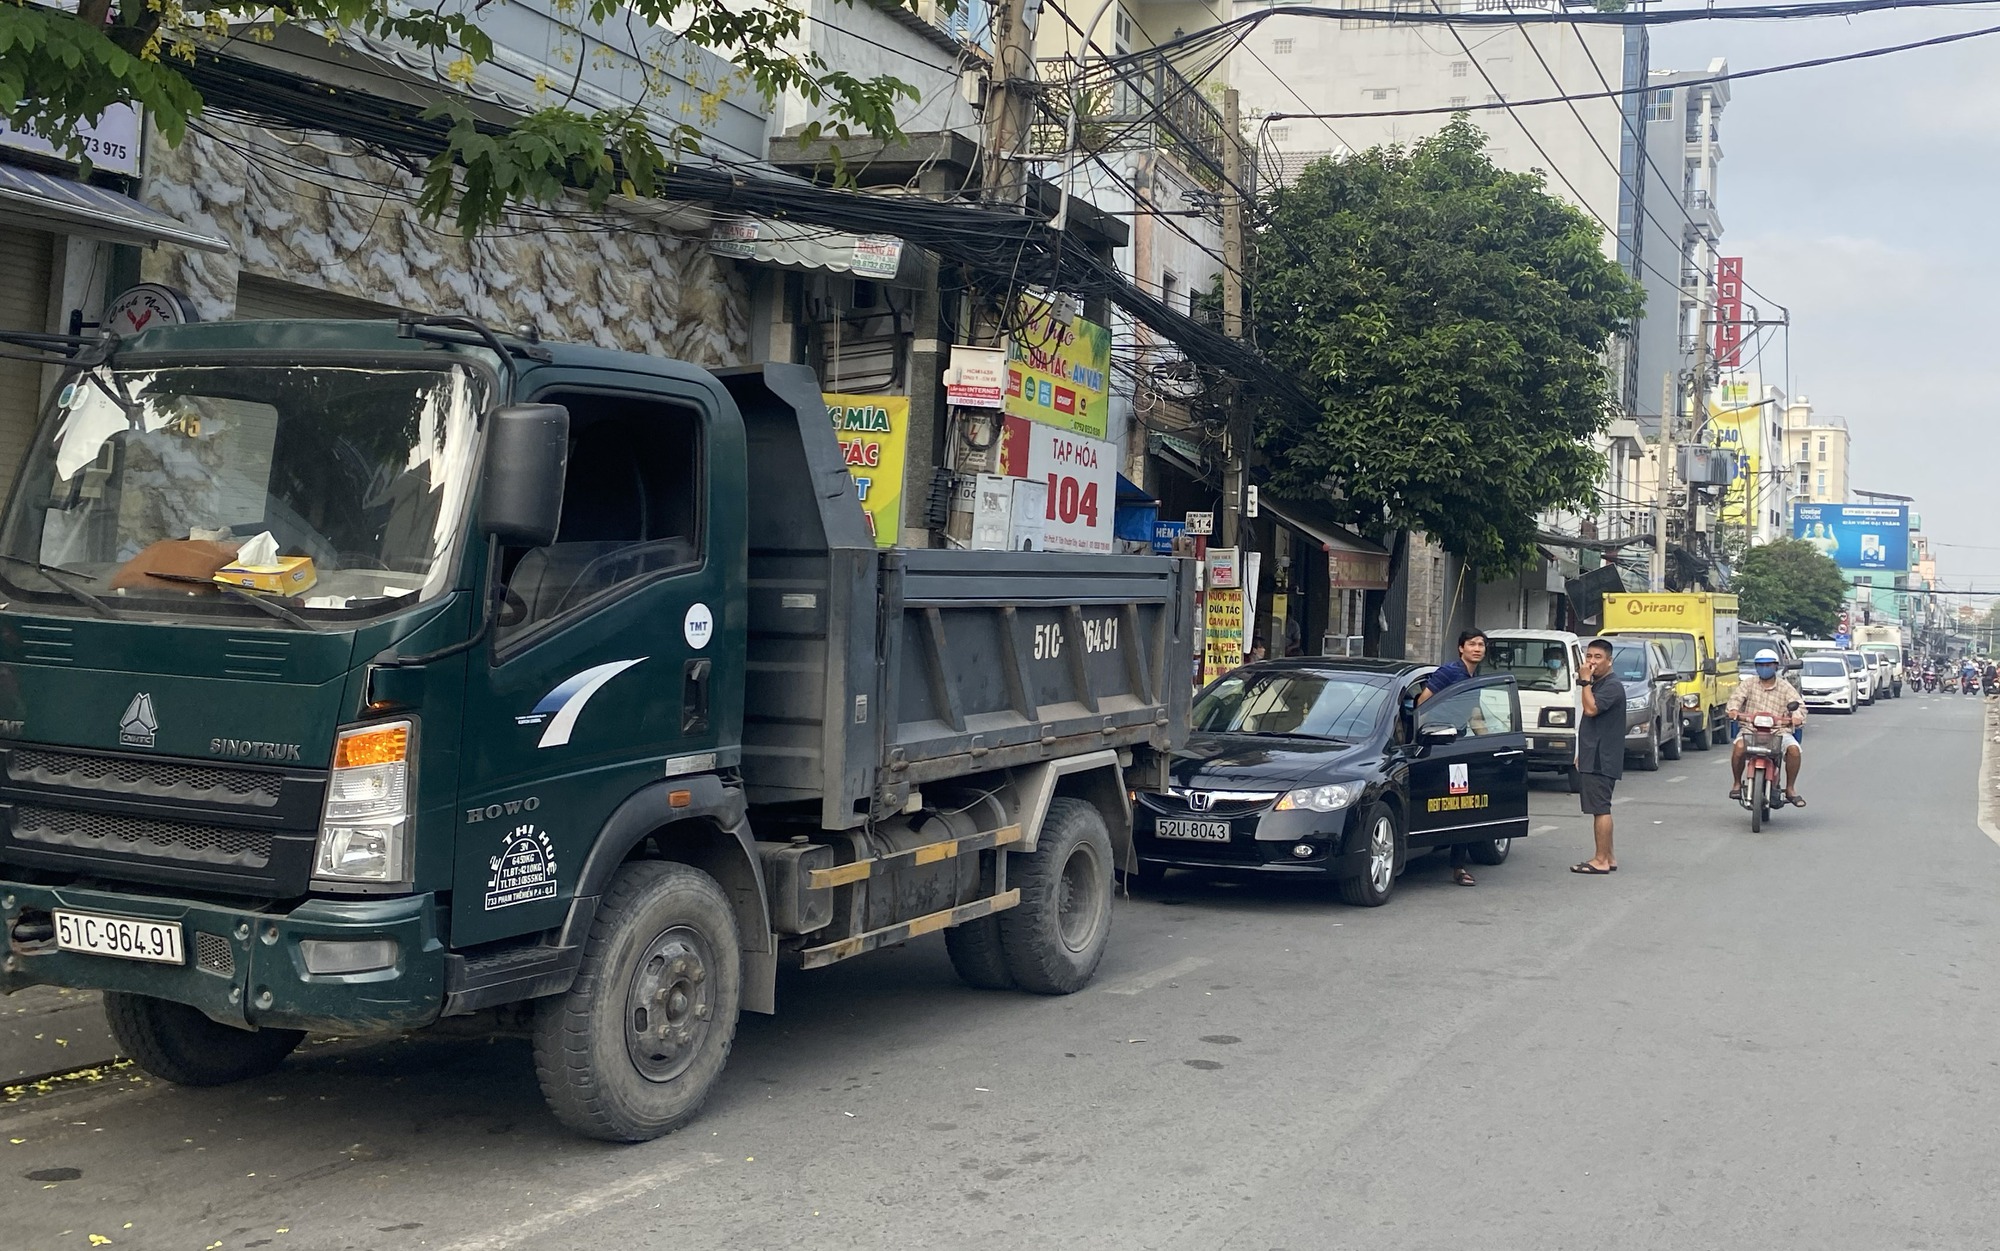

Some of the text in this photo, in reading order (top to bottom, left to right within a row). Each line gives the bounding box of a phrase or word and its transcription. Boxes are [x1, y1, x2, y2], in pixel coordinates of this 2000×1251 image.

[103, 141, 126, 160] 975
[1722, 261, 1737, 362] HOTEL
[967, 387, 999, 395] INTERNET
[1045, 473, 1098, 528] 104
[689, 621, 708, 632] TMT
[209, 737, 301, 761] SINOTRUK
[466, 796, 541, 824] HOWO
[58, 915, 176, 959] 51C-964.91
